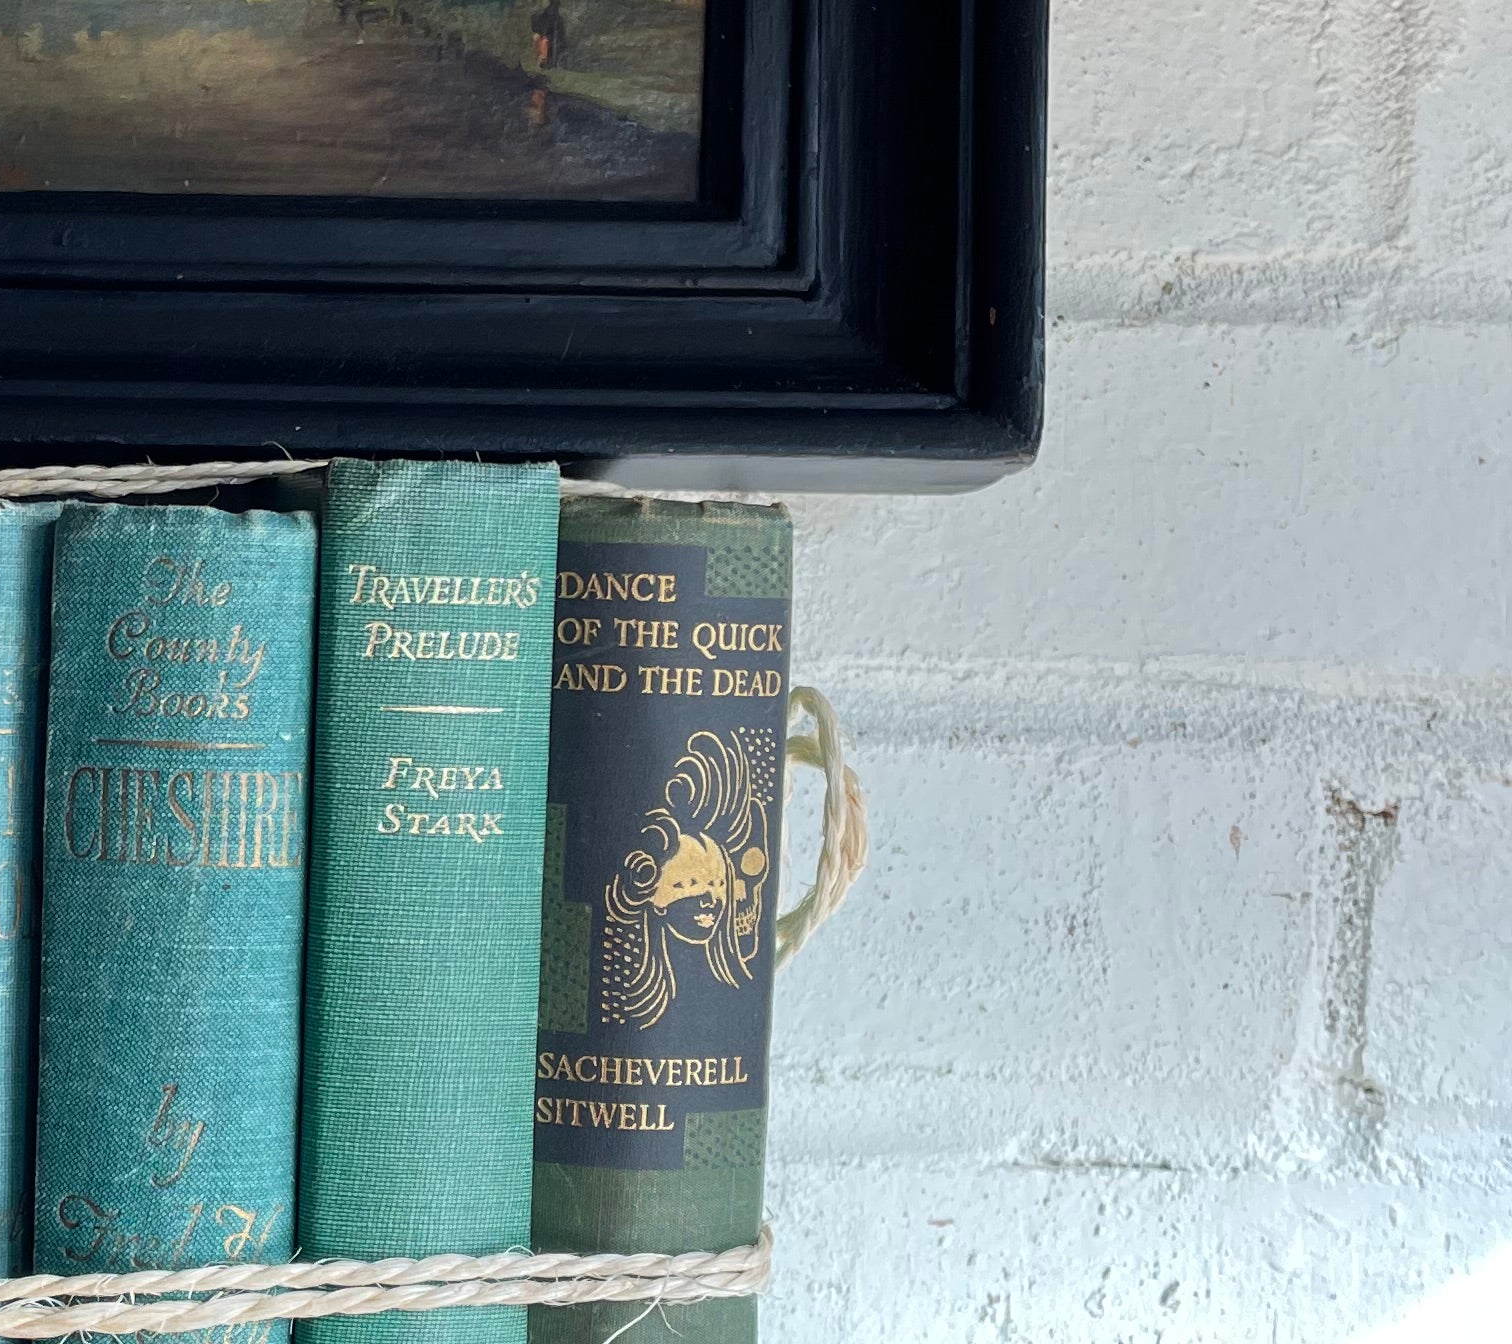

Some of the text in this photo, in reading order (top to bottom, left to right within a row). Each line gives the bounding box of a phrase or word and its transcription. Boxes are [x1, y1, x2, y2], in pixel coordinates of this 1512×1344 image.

[145, 555, 232, 607] The
[556, 571, 678, 603] DANCE
[106, 610, 266, 689] County
[364, 620, 521, 661] PRELUDE
[557, 617, 784, 660] OF THE QUICK
[108, 667, 252, 721] Books
[553, 663, 783, 697] AND THE DEAD
[381, 756, 505, 800] FREYA
[63, 765, 304, 870] CHESHIRE
[378, 803, 504, 844] STARK
[537, 1051, 749, 1088] SACHEVERELL
[535, 1096, 676, 1131] SITWELL
[149, 1082, 206, 1189] by
